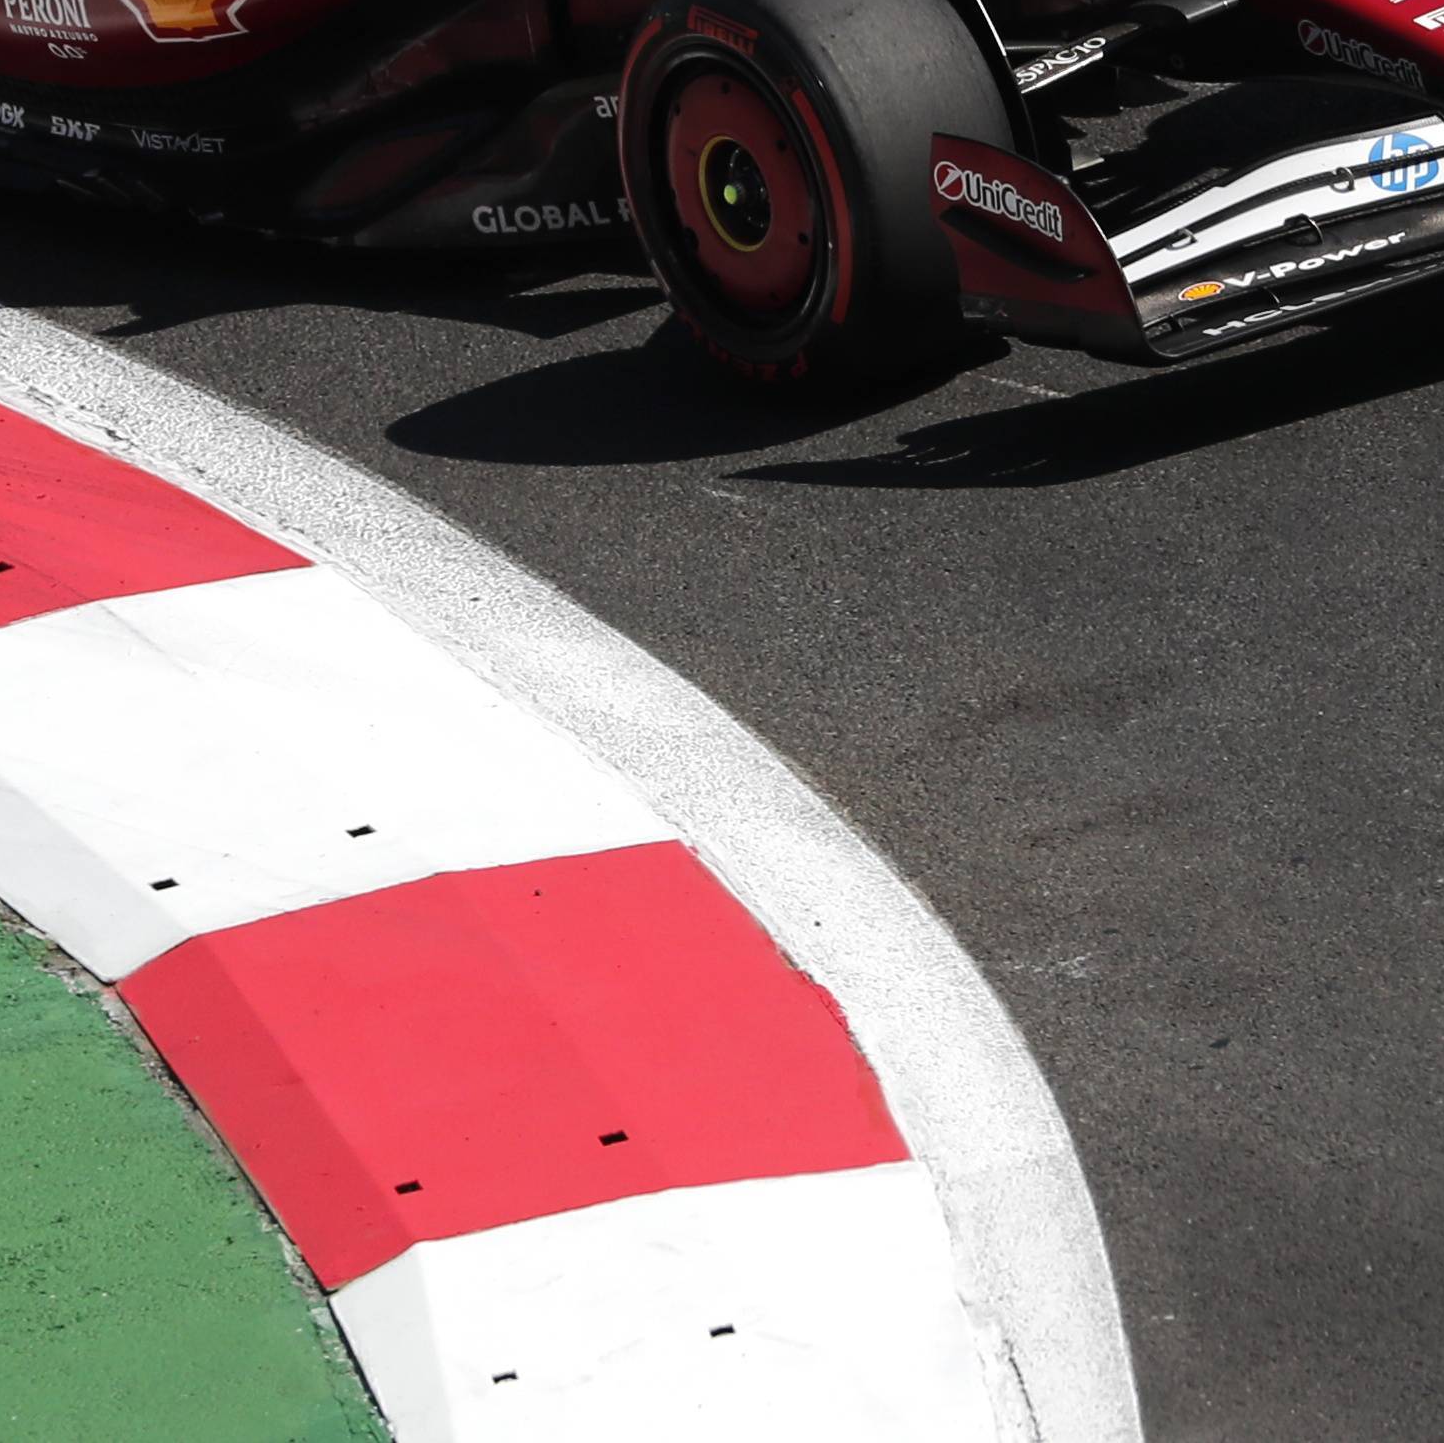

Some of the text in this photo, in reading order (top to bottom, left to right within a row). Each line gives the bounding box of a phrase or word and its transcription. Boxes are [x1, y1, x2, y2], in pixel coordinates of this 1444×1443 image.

[9, 23, 99, 43] NASTRO AZZURRO
[1321, 29, 1428, 94] UniCredit
[49, 114, 101, 143] SKF
[1374, 132, 1434, 192] hp
[471, 200, 611, 234] GLOBAL
[964, 170, 1063, 243] UniCredit
[1224, 229, 1407, 290] V-Power
